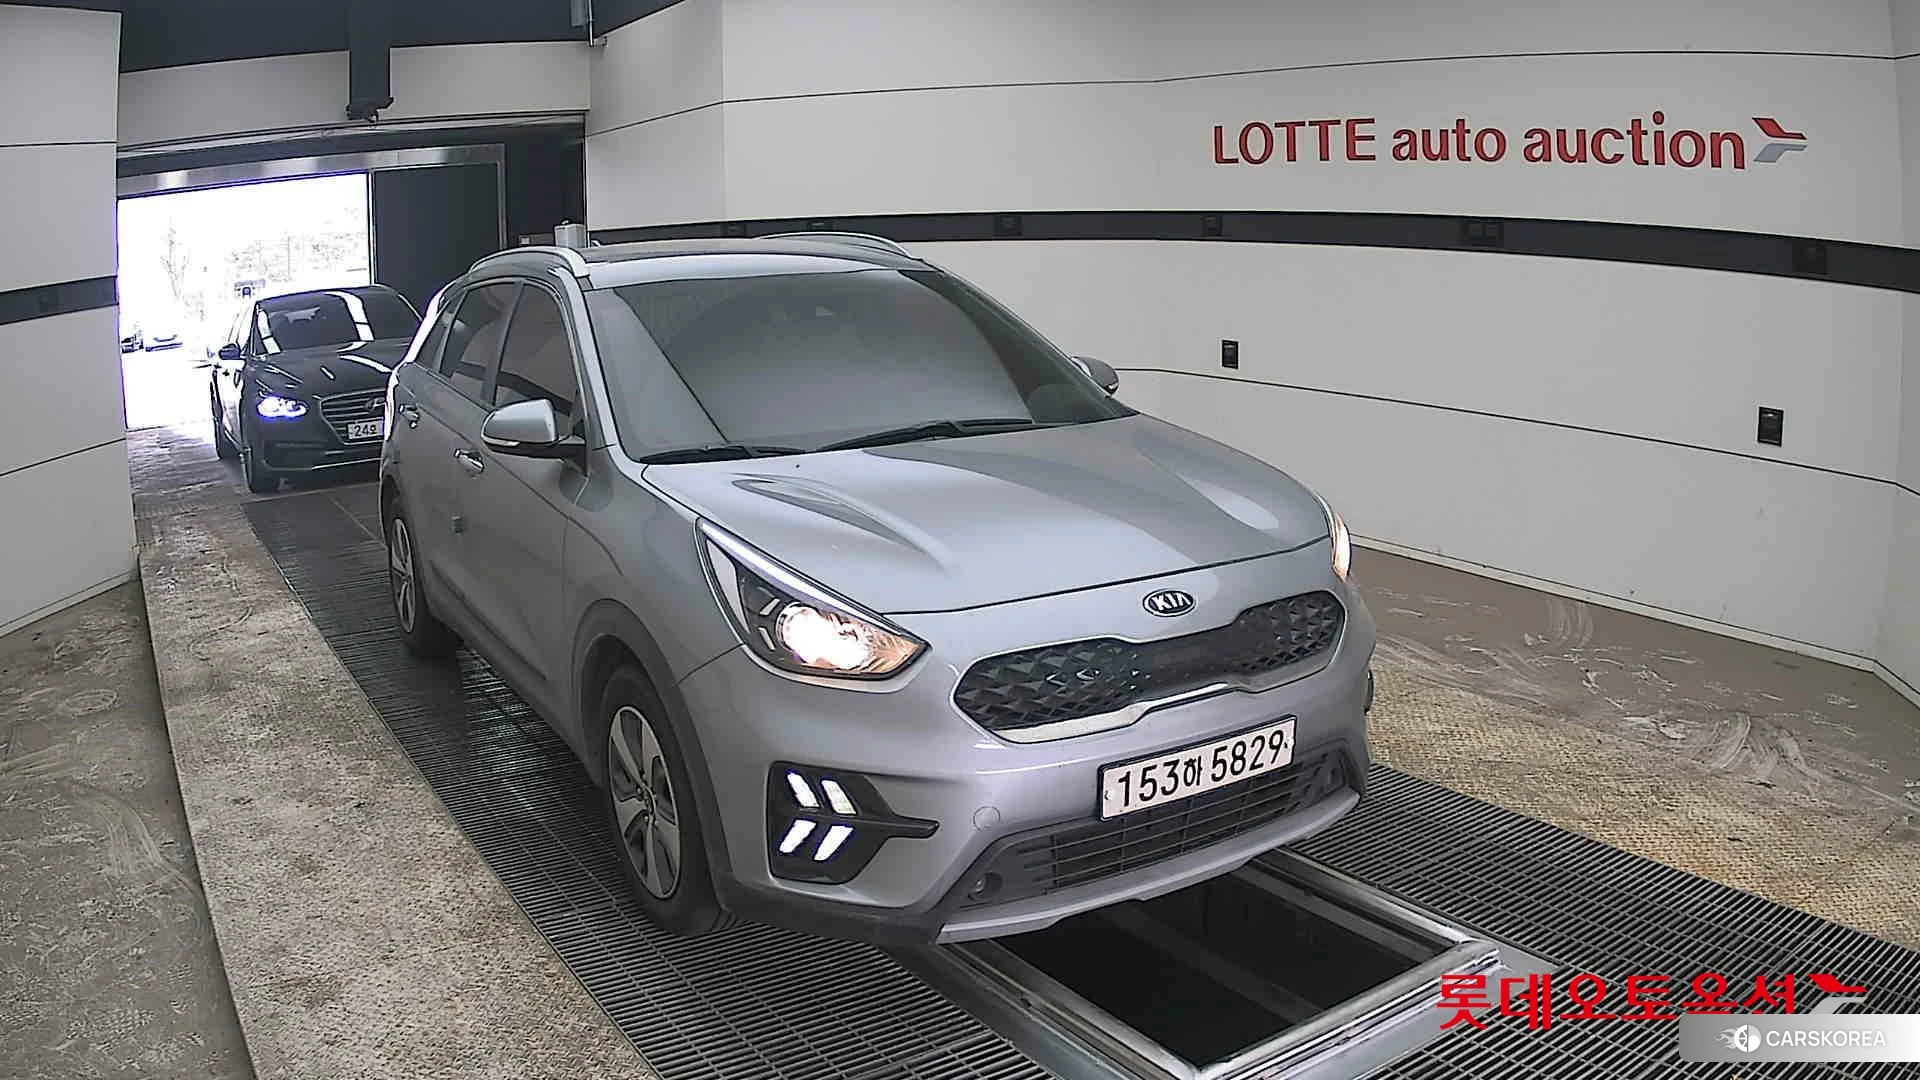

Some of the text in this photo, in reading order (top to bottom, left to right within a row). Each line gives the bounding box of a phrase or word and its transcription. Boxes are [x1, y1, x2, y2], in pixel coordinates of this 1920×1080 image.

[1213, 110, 1747, 170] LOTTE auto auction
[1151, 592, 1192, 611] KIA
[1118, 729, 1285, 808] 153하 5829
